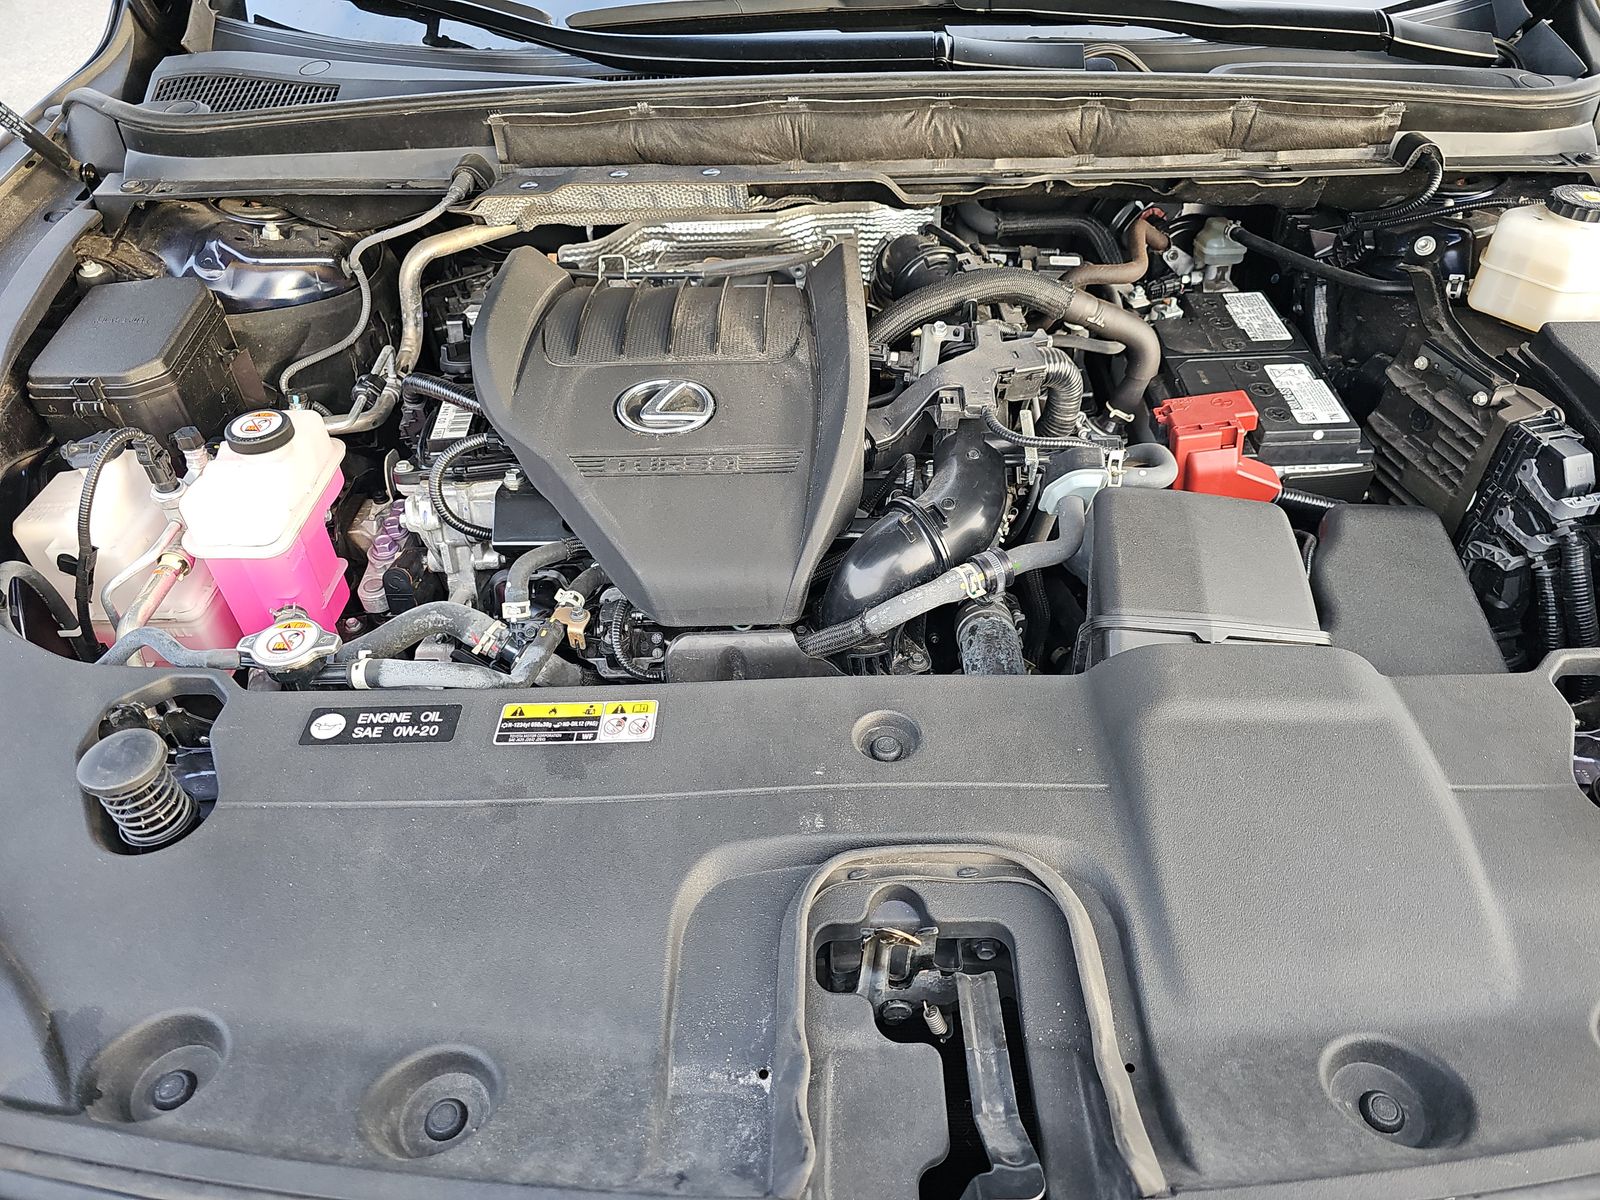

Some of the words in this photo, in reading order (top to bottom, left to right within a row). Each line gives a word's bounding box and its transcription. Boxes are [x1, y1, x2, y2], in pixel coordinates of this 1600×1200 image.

[357, 712, 412, 723] ENGINE
[420, 711, 443, 723] OIL
[352, 726, 384, 739] SAE
[393, 725, 439, 738] 0W-20
